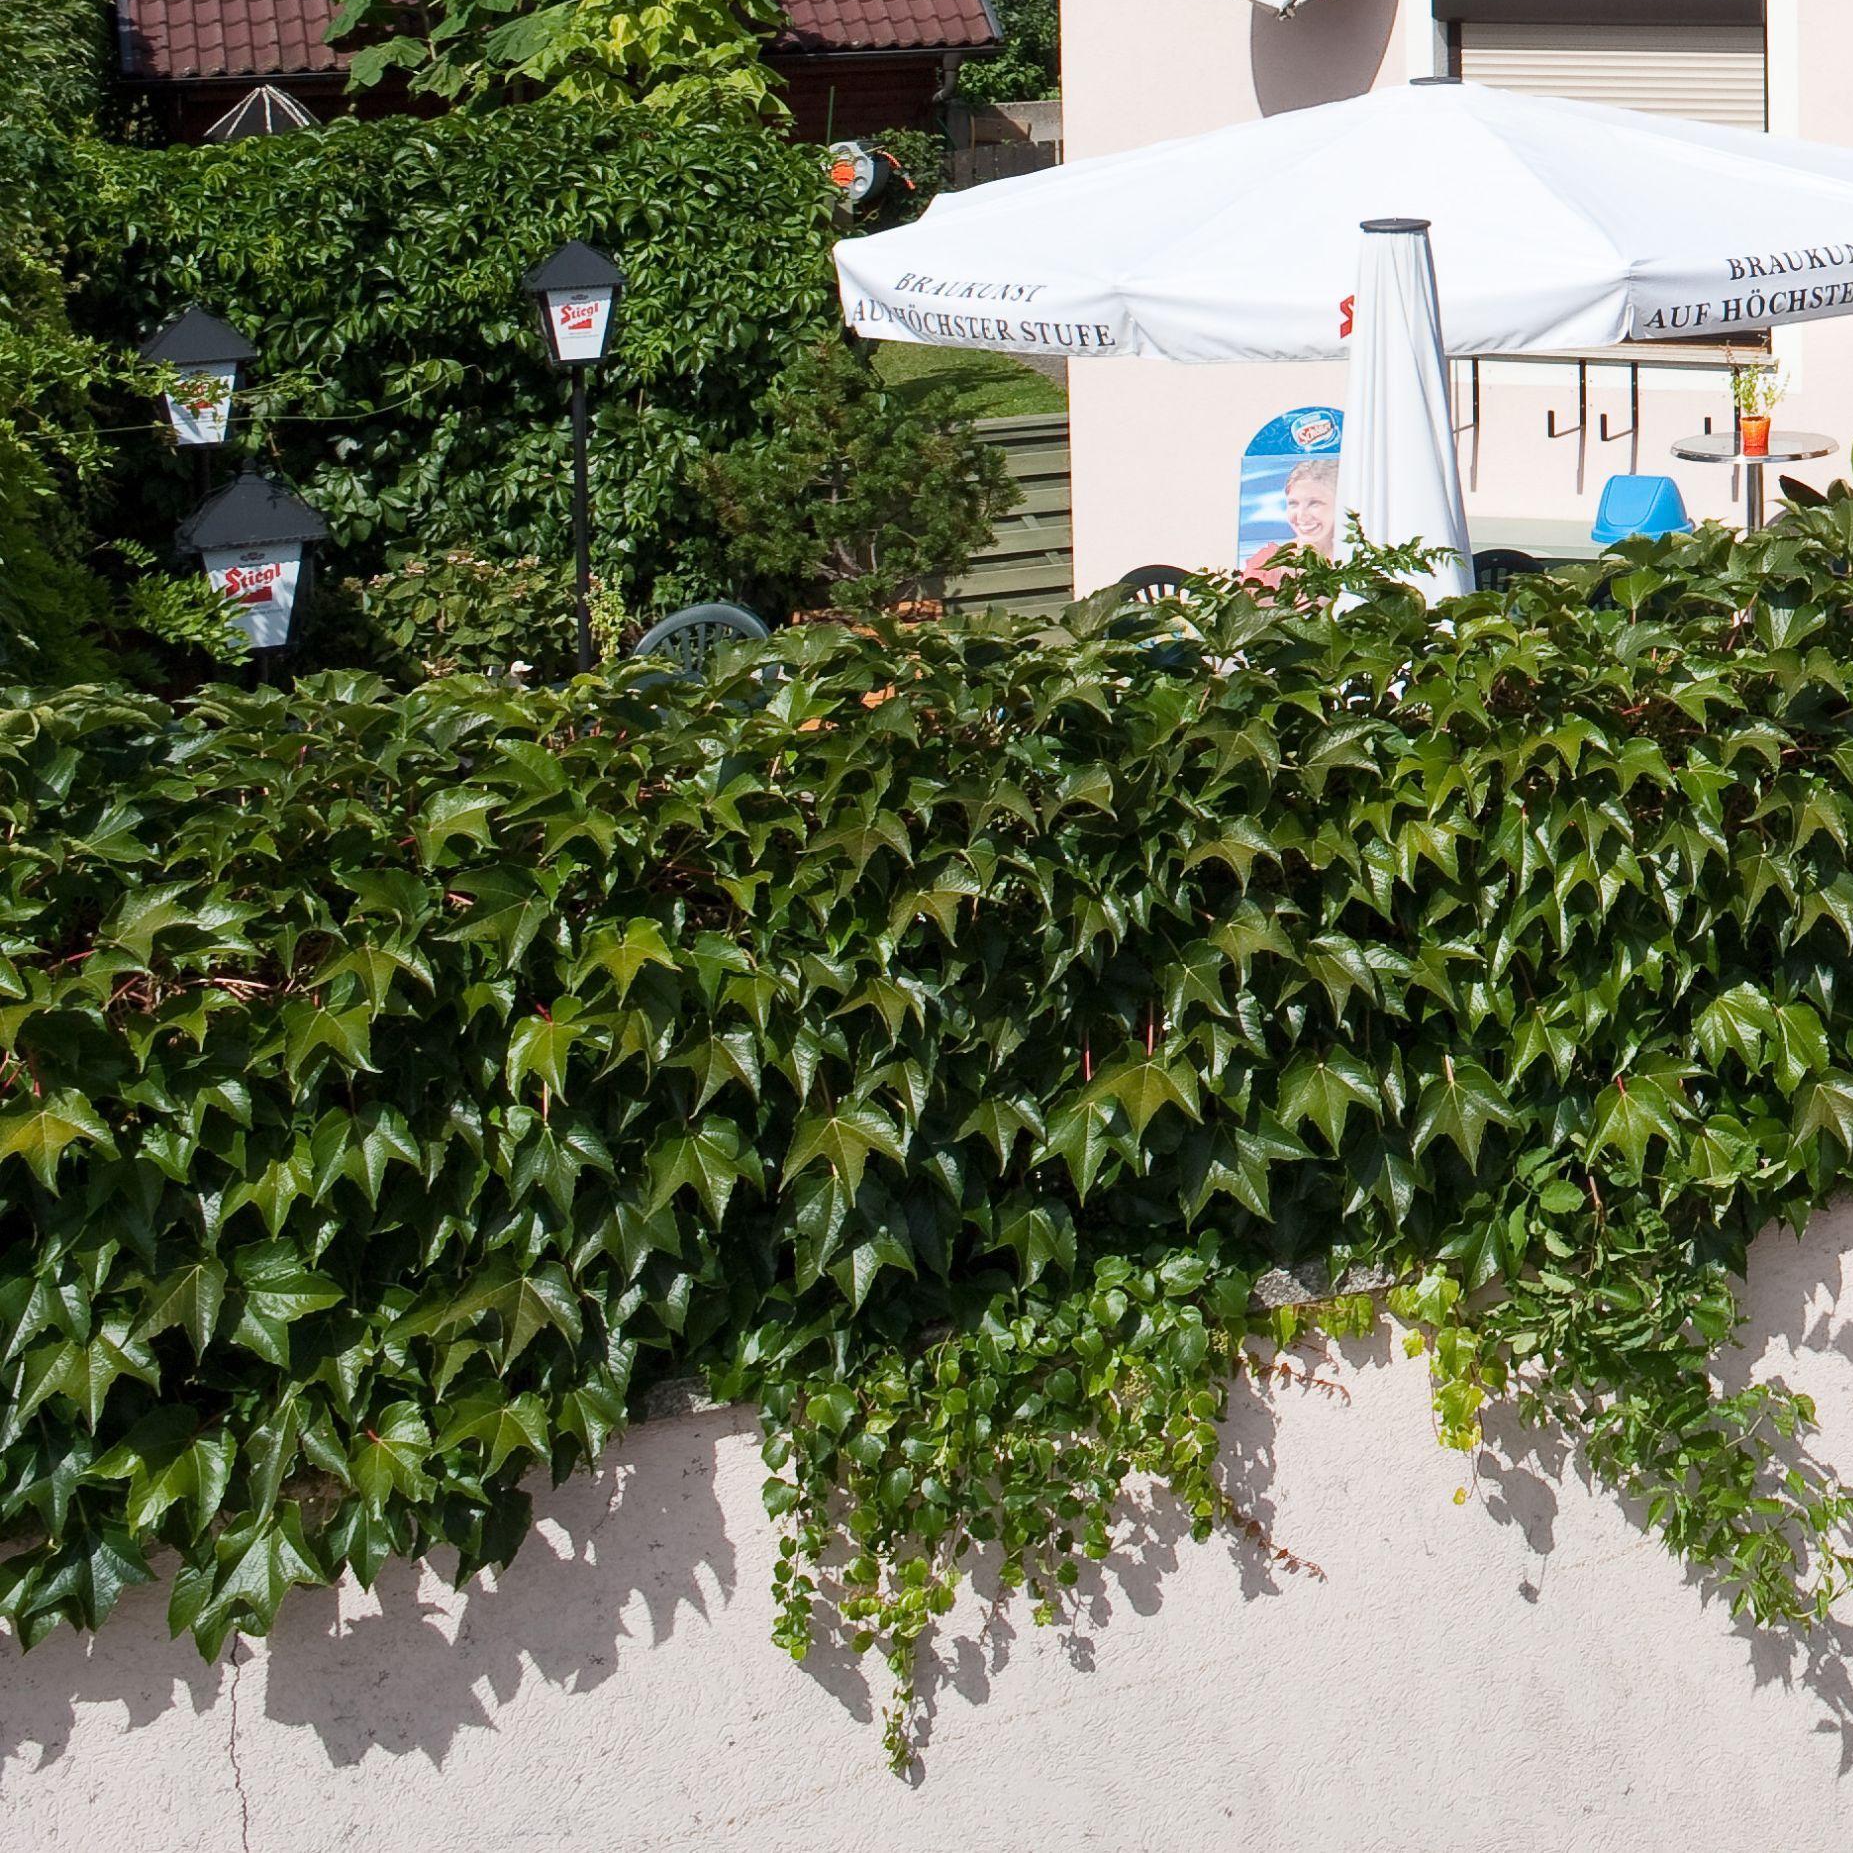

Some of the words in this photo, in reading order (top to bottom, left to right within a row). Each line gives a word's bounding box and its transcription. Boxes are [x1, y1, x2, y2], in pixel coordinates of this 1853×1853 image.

[894, 272, 1048, 303] BRAUKUNST
[561, 303, 599, 326] Stiegl
[1644, 302, 1712, 330] AUF
[1020, 320, 1116, 347] STUFE
[225, 562, 281, 599] Stiegl
